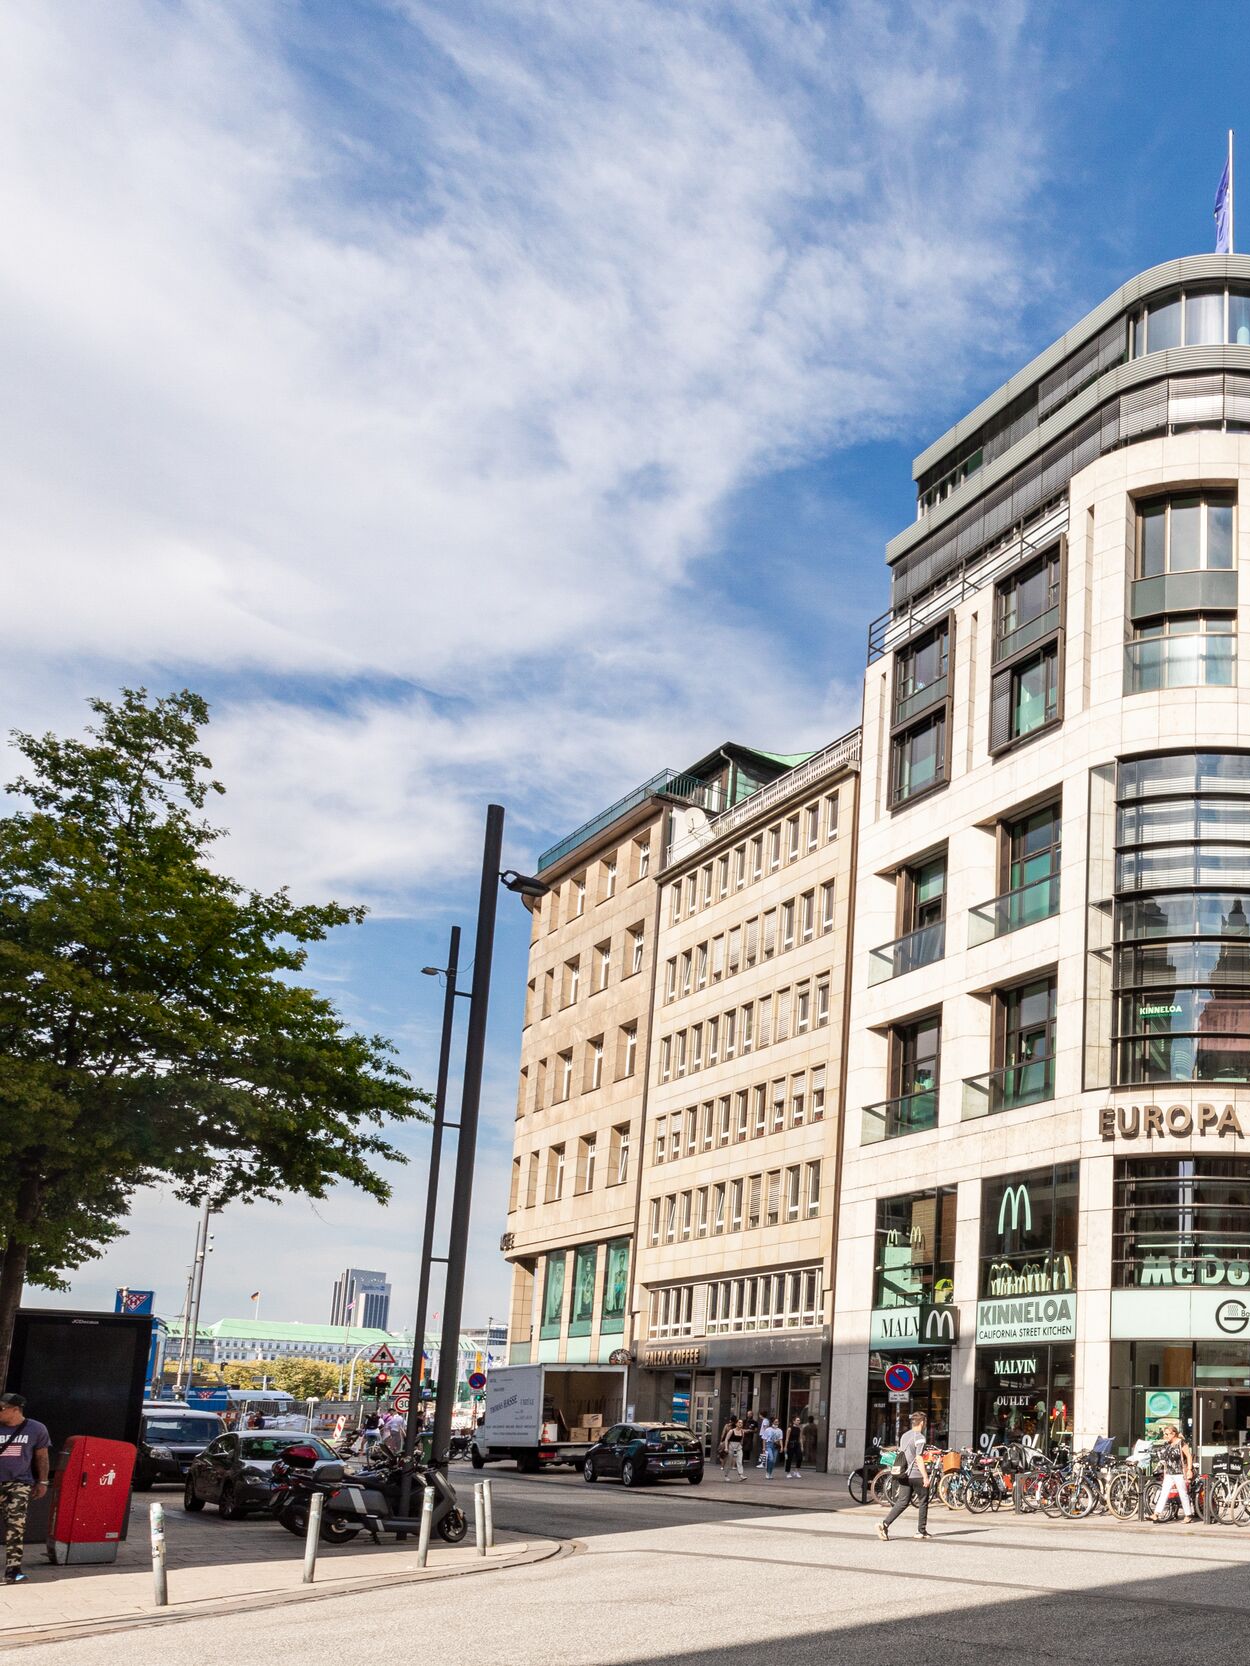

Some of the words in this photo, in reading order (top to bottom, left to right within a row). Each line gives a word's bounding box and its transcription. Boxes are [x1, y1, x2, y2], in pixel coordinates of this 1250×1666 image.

[1140, 1005, 1182, 1015] KINNELOA
[1099, 1103, 1243, 1136] EUROPA
[980, 1299, 1072, 1326] KINNELOA
[979, 1329, 1017, 1340] CALIFORNIA
[1019, 1327, 1041, 1337] STREET
[1043, 1325, 1072, 1336] KITCHEN
[645, 1350, 671, 1366] BALZAC
[672, 1348, 700, 1364] COFFEE
[994, 1359, 1037, 1374] MALVIN
[996, 1395, 1031, 1406] OUTLET
